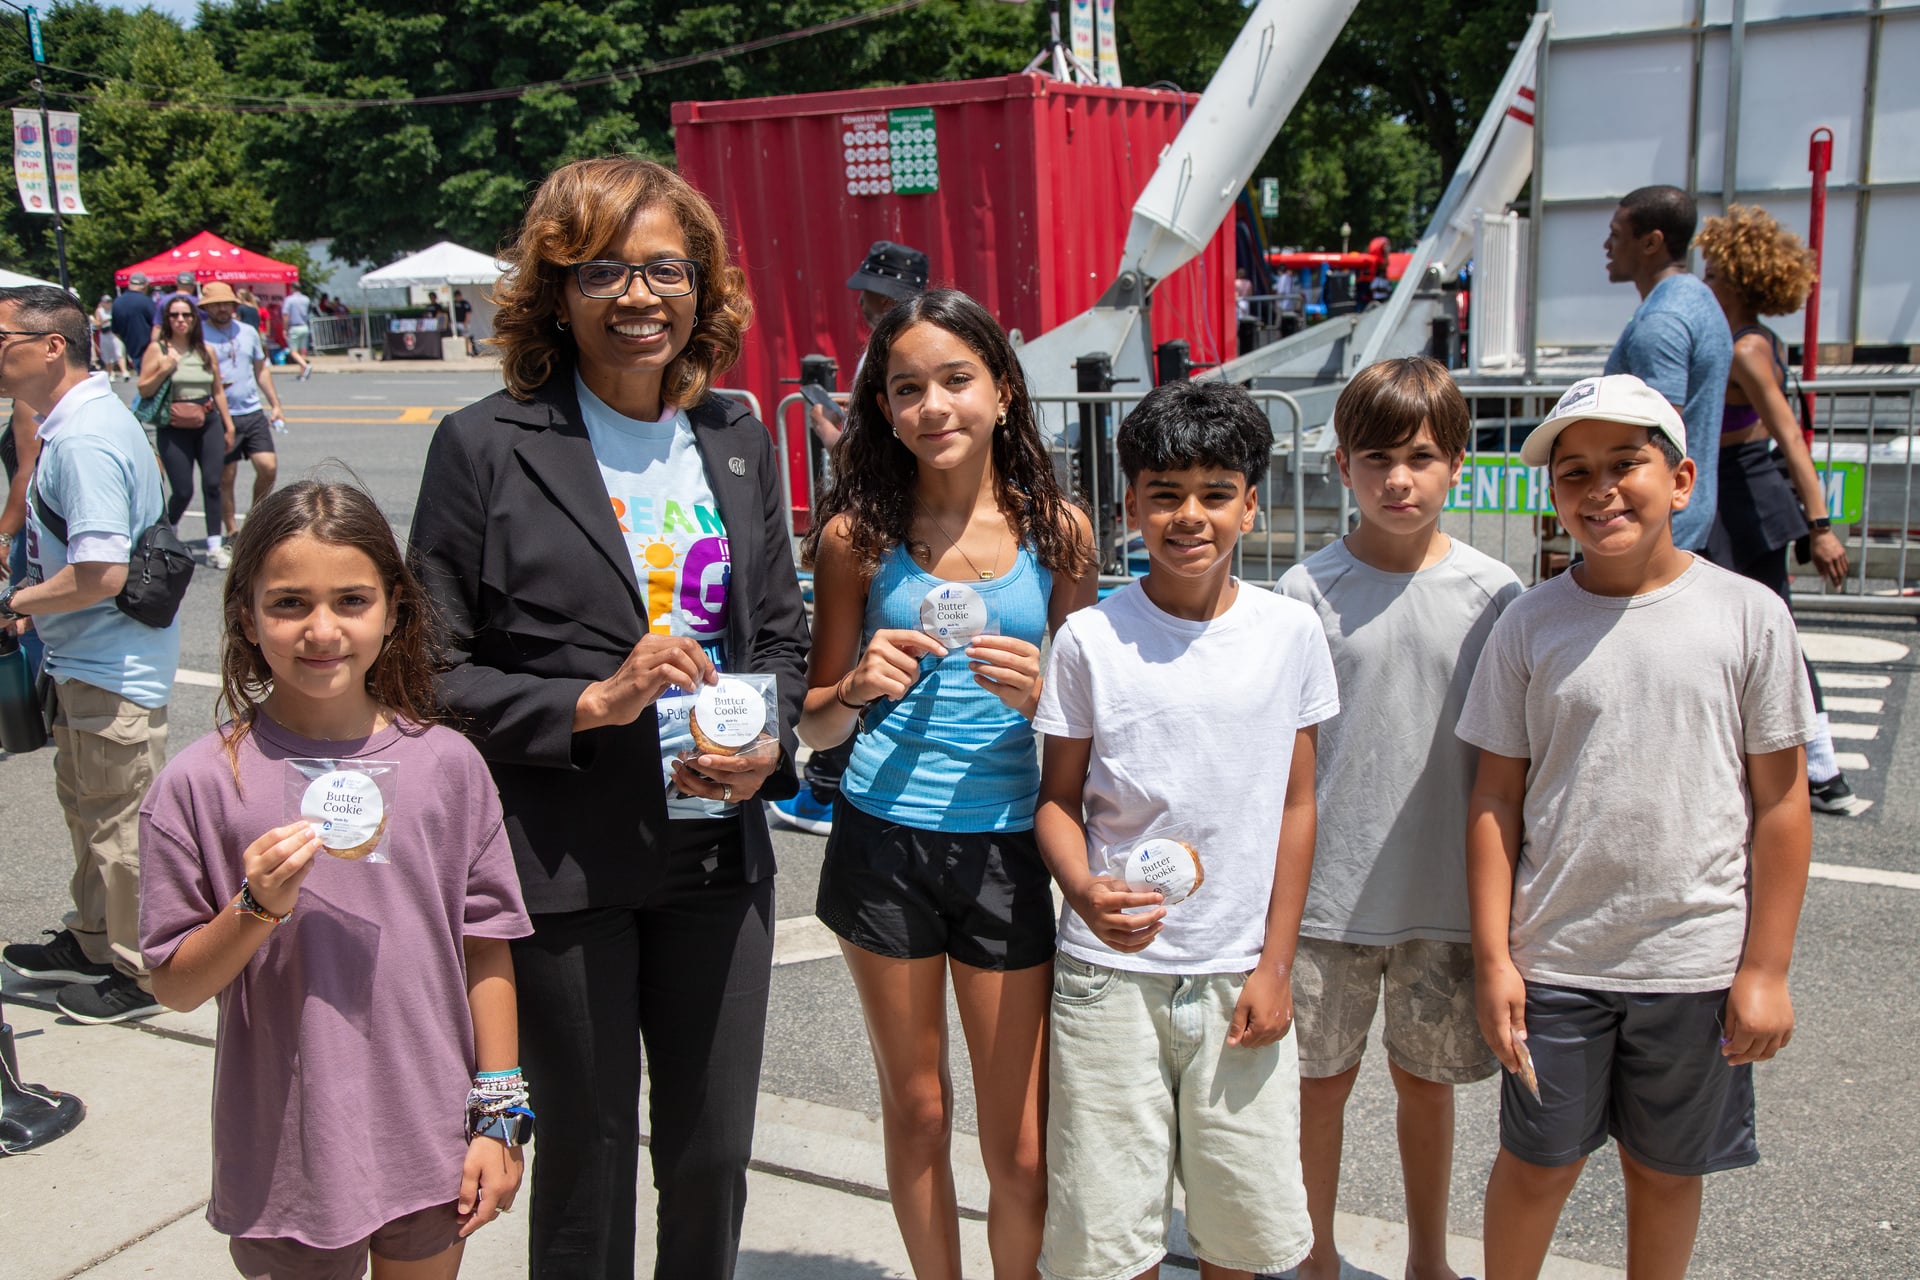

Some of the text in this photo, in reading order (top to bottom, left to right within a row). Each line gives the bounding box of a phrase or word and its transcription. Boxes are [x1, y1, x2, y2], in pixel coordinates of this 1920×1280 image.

[17, 150, 41, 159] FOOD
[52, 152, 75, 160] FOOD
[22, 161, 40, 169] FUN
[938, 602, 967, 611] Butter
[937, 611, 969, 620] Cookie
[714, 697, 745, 706] Butter
[666, 708, 688, 720] Pub
[714, 706, 748, 716] Cookie
[326, 791, 363, 804] Butter
[323, 802, 363, 815] Cookie
[1141, 856, 1171, 875] Butter
[1144, 865, 1177, 884] Cookie
